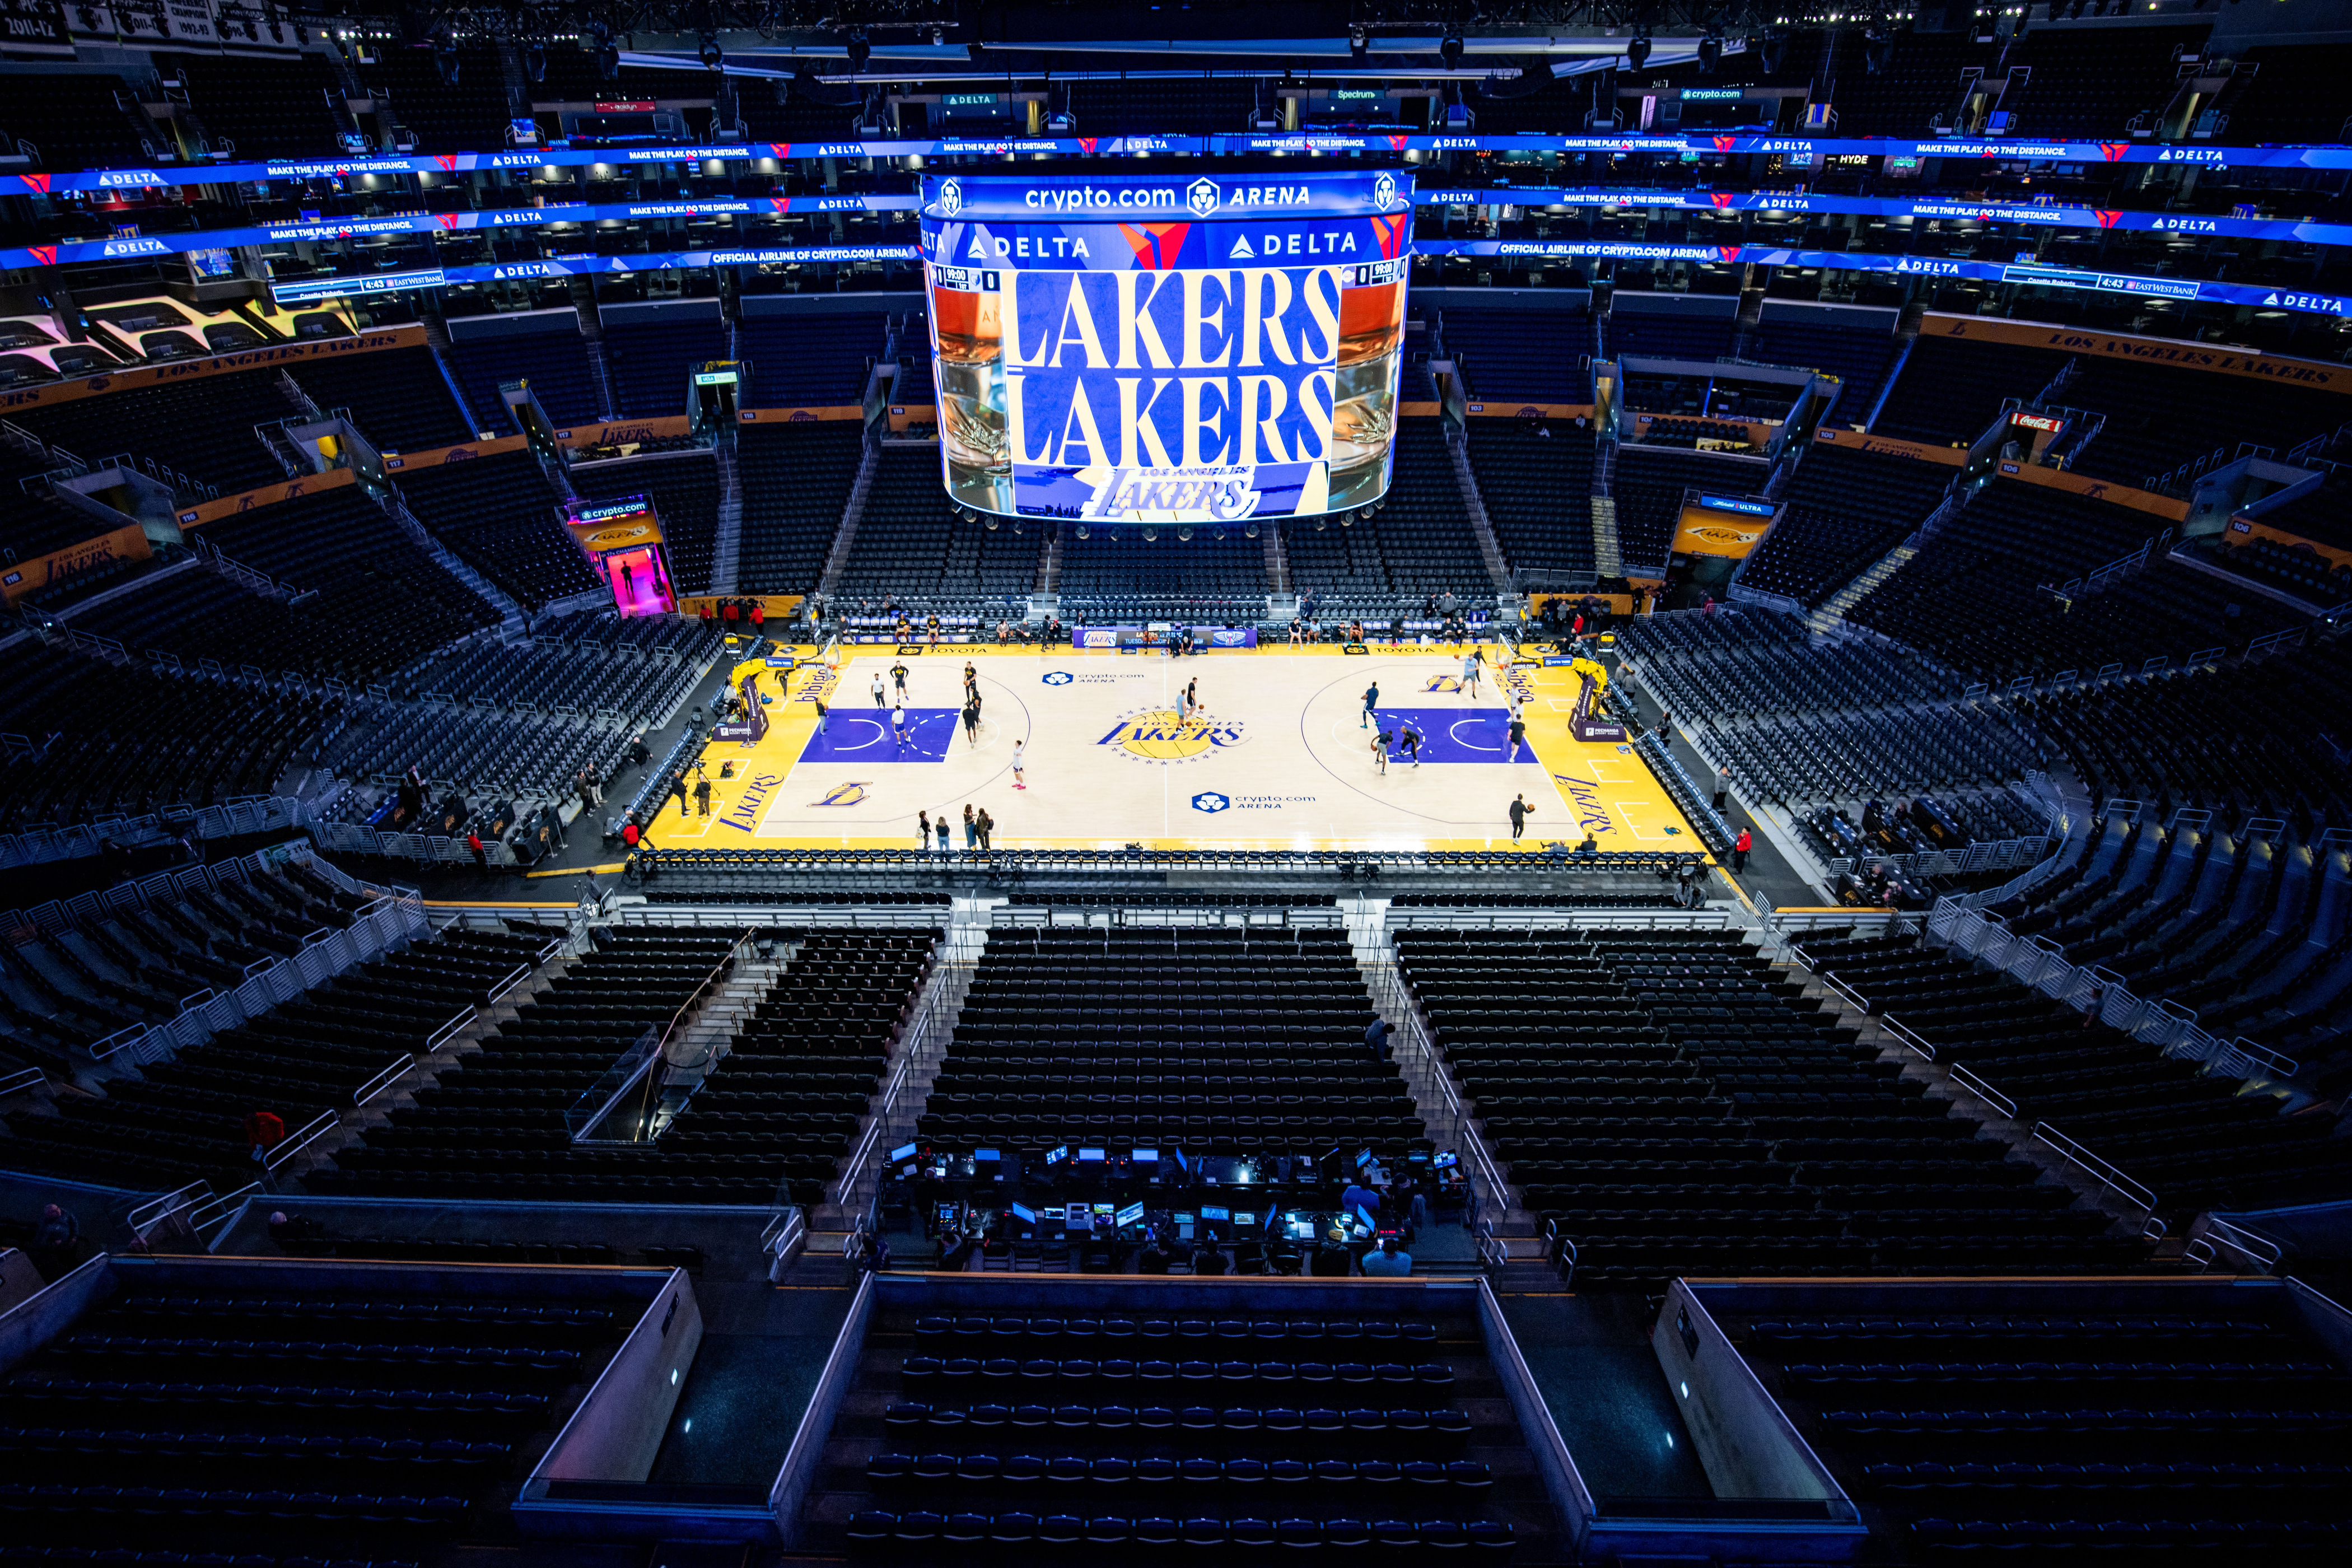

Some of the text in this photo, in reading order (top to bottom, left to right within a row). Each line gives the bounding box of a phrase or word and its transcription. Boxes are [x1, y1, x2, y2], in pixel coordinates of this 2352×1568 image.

[1338, 90, 1373, 100] Spectrum
[1692, 90, 1740, 99] crypto.com
[829, 144, 862, 154] DELTA
[1135, 140, 1167, 148] DELTA
[1443, 138, 1477, 147] DELTA
[1774, 141, 1812, 150] DELTA
[503, 155, 542, 165] DELTA
[1840, 155, 1868, 164] HYDE
[2174, 150, 2223, 160] DELTA
[268, 166, 294, 175] MAKE
[313, 164, 336, 172] PLAY.
[368, 161, 410, 170] DISTANCE.
[113, 173, 161, 184] DELTA
[829, 199, 863, 208] DELTA
[1026, 185, 1310, 212] crypto.com ARENA
[1441, 193, 1474, 202] DELTA
[1771, 199, 1809, 208] DELTA
[505, 212, 542, 222] DELTA
[1913, 206, 1939, 214] MAKE
[1956, 208, 1978, 216] PLAY.
[2014, 211, 2061, 221] DISTANCE.
[270, 230, 297, 239] MAKE
[297, 228, 314, 237] THE
[315, 227, 338, 235] PLAY.
[353, 224, 371, 232] THE
[371, 221, 413, 231] DISTANCE.
[2167, 219, 2215, 231] DELTA
[117, 240, 165, 254] DELTA
[995, 236, 1090, 258] DELTA
[1264, 231, 1356, 255] DELTA
[713, 248, 908, 263] OFFICIAL AIRLINE OF CRYPTO.COM ARENA
[1501, 245, 1545, 254] OFFICIAL
[1546, 246, 1585, 254] AIRLINE
[1602, 247, 1672, 256] CRYPTO.COM
[1673, 249, 1707, 258] ARENA
[507, 264, 550, 276] DELTA
[1375, 262, 1393, 275] 99:00
[1912, 261, 1959, 274] DELTA
[947, 268, 966, 281] 99:00
[987, 273, 994, 288] 0
[1360, 267, 1366, 283] 0
[365, 279, 385, 289] 4:43
[2101, 278, 2124, 288] 4:43
[2284, 295, 2341, 312] DELTA
[1004, 267, 1339, 369] LAKERS
[157, 335, 396, 378] LOS ANGELES LAKERS
[2049, 334, 2332, 384] LOS ANGELES LAKERS
[1008, 372, 1335, 466] LAKERS
[1139, 465, 1250, 477] LOS ANGELES
[2004, 464, 2018, 473] 106
[1095, 468, 1254, 520] LAKERS
[592, 503, 646, 517] crypto.com
[2234, 522, 2250, 533] 106
[616, 545, 648, 555] CHAMPIONS
[1084, 634, 1116, 645] LAKERS
[795, 669, 837, 702] bibigo
[1095, 722, 1252, 747] LAKERS
[718, 772, 784, 834] LAKERS
[1552, 772, 1617, 835] LAKERS
